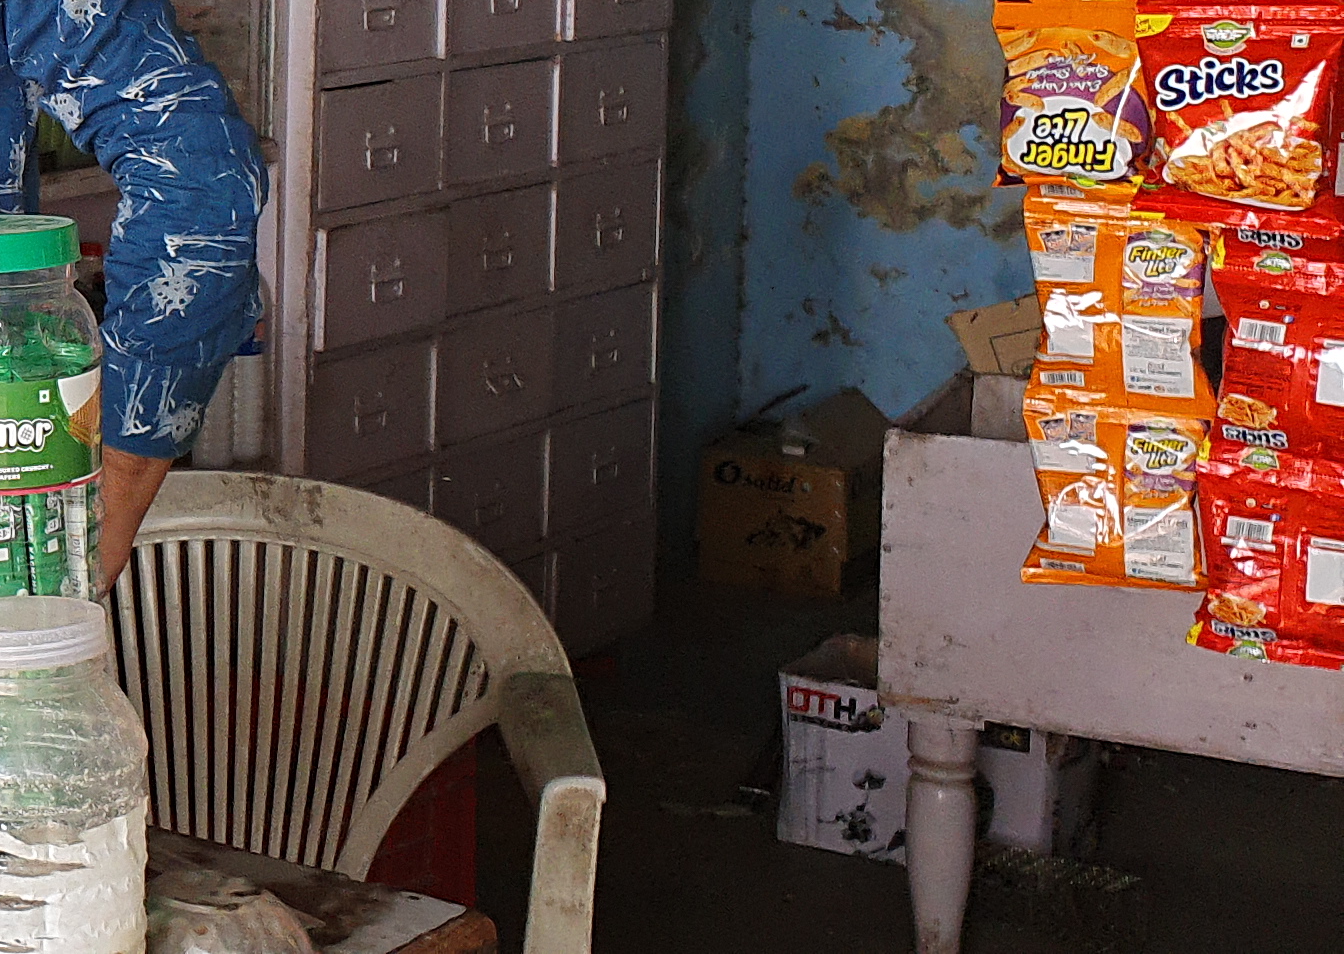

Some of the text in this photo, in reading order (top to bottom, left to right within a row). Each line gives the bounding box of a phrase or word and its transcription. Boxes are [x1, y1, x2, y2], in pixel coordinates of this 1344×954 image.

[1157, 62, 1282, 108] Sticks
[1033, 108, 1088, 144] Lite
[1020, 139, 1116, 173] Finger
[1129, 245, 1187, 263] Finger
[787, 685, 856, 722] DTH
